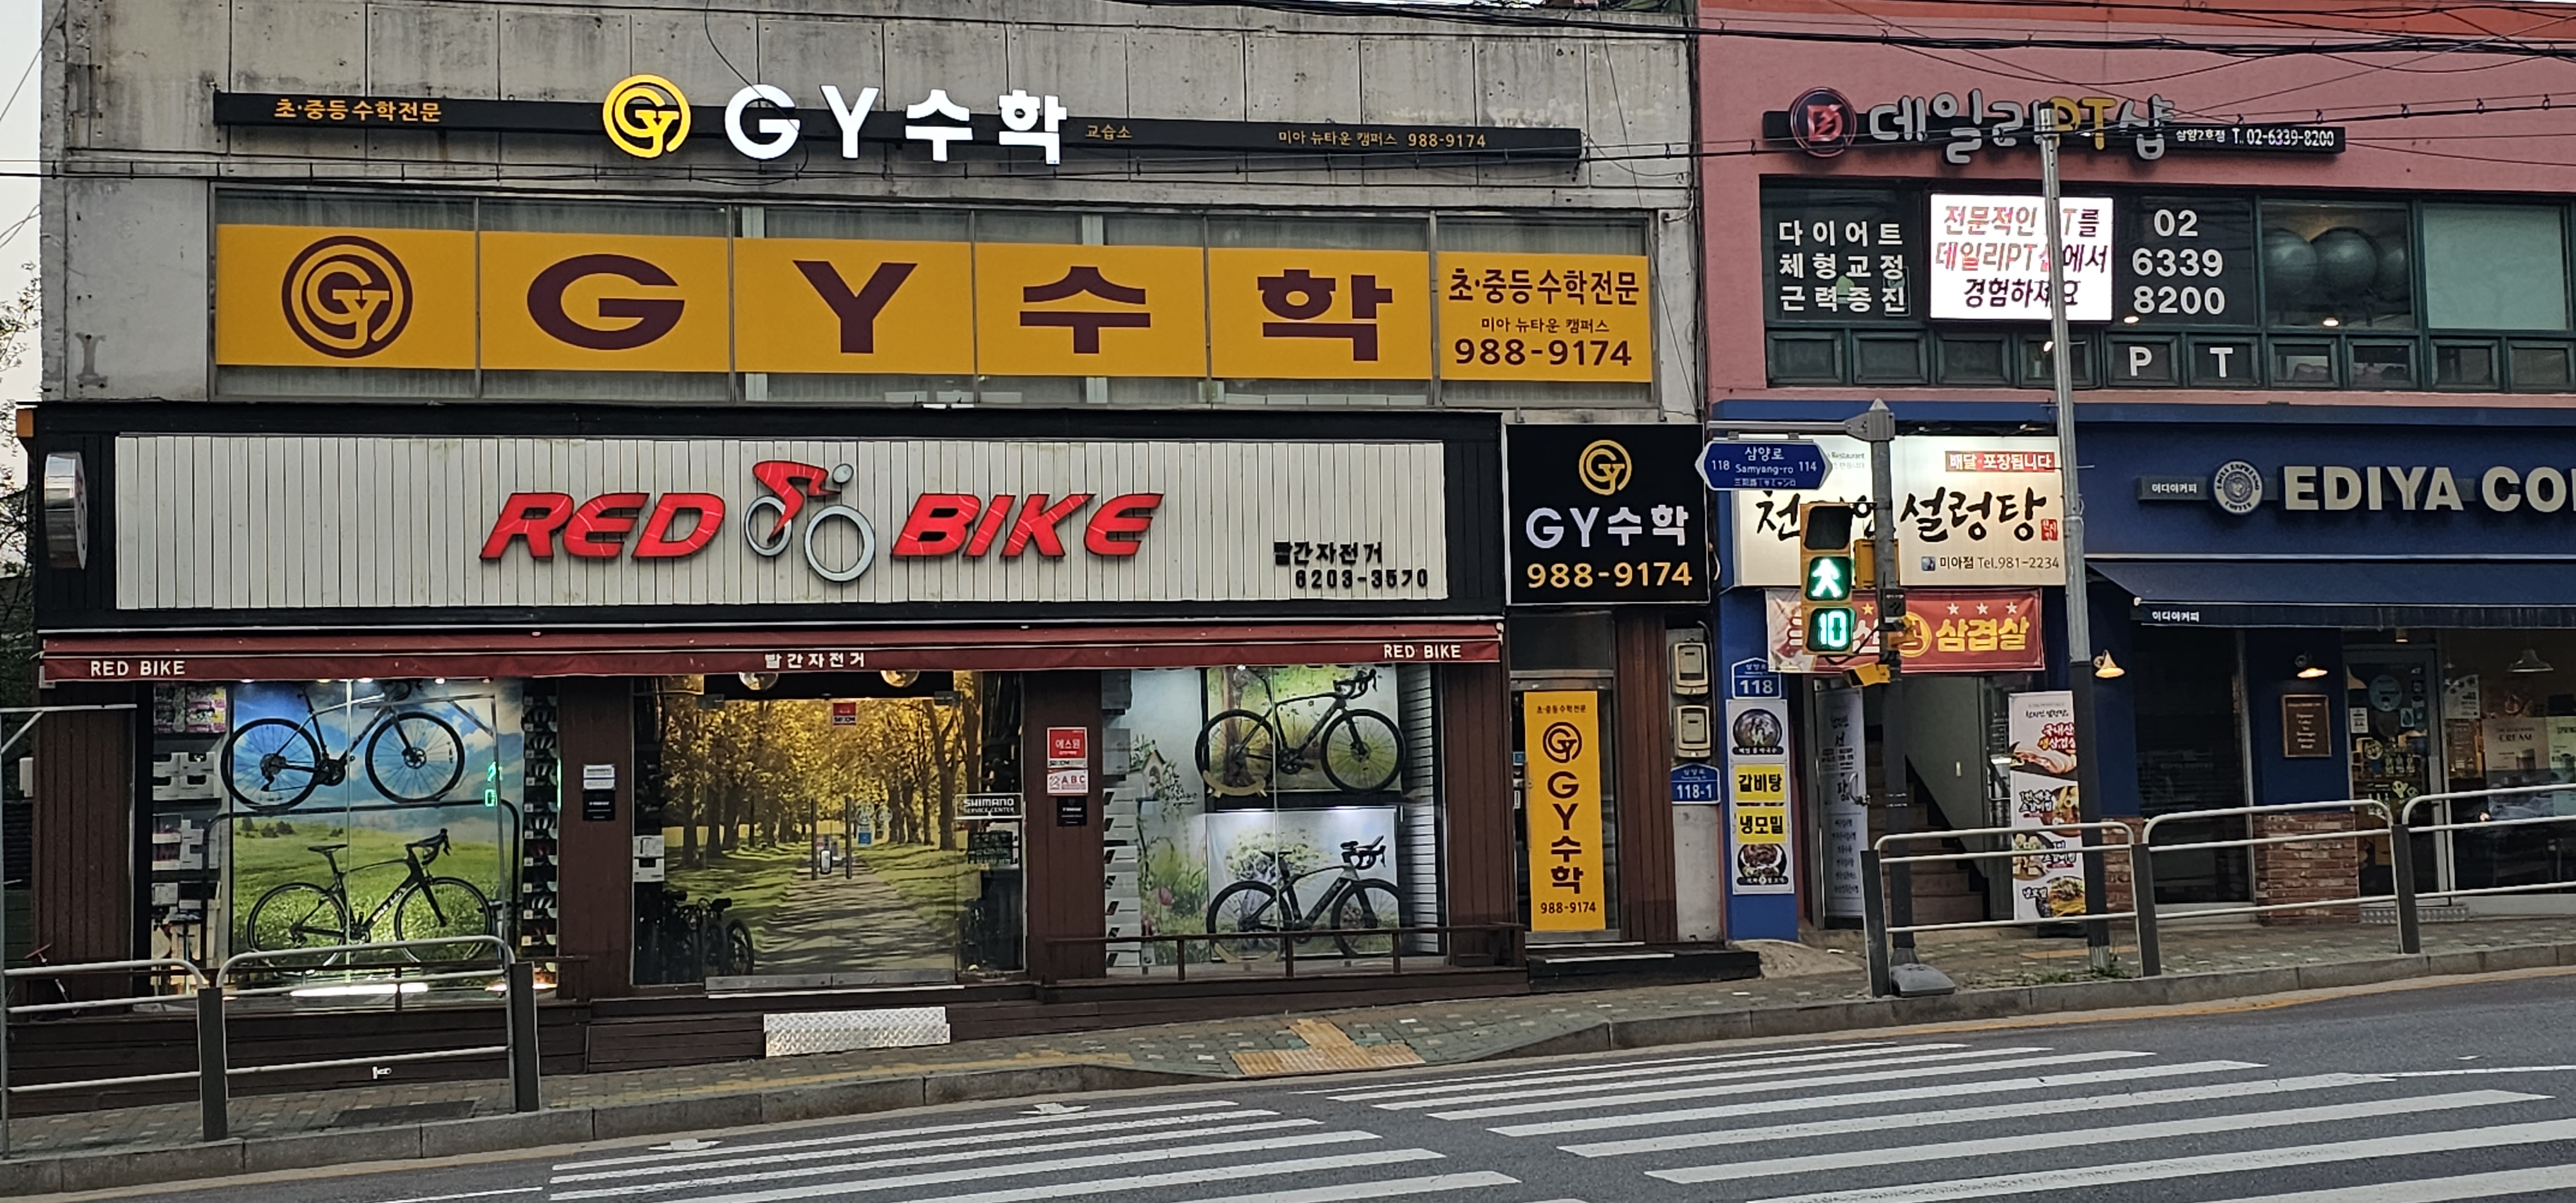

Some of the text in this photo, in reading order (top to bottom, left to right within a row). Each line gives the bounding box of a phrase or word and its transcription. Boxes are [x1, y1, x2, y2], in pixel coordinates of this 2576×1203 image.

[1085, 124, 1132, 141] 교습소
[1278, 131, 1486, 148] 미아 뉴타운 캠퍼스 988-9174
[2247, 129, 2334, 147] 02-6339-8200
[1944, 205, 2038, 237] 전문적인
[2154, 209, 2199, 238] 02
[1779, 220, 1904, 247] 다이어트
[1779, 253, 1904, 280] 체형교정
[2132, 248, 2223, 278] 6339
[1780, 285, 1906, 313] 근력증진
[2134, 286, 2225, 315] 8200
[1481, 317, 1609, 334] 미아 뉴타운 캠퍼스
[1454, 338, 1633, 366] 988-9174
[1744, 446, 1785, 462] 삼양로
[1711, 460, 1730, 471] 118
[1735, 464, 1794, 475] Samyang-ro
[1798, 461, 1817, 472] 114
[2283, 466, 2576, 513] EDIYA CO
[1899, 486, 2047, 543] 설렁탕
[480, 492, 1164, 561] RED BIKE
[1526, 505, 1689, 549] GY수학
[1940, 556, 1975, 570] 미아점
[1294, 568, 1428, 589] 6203-3570
[1527, 562, 1693, 588] 988-9174
[1818, 611, 1848, 648] 10
[1936, 616, 2031, 652] 삼겹살
[1383, 645, 1462, 659] RED BIKE
[91, 660, 185, 676] RED BIKE
[1739, 679, 1774, 694] 118
[1055, 739, 1081, 750] 에스원
[1676, 783, 1712, 799] 118-1
[1738, 773, 1783, 793] 갈비탕
[963, 798, 1015, 808] SHIMANO
[1739, 815, 1783, 835] 냉모밀
[1540, 902, 1597, 914] 988-9174
